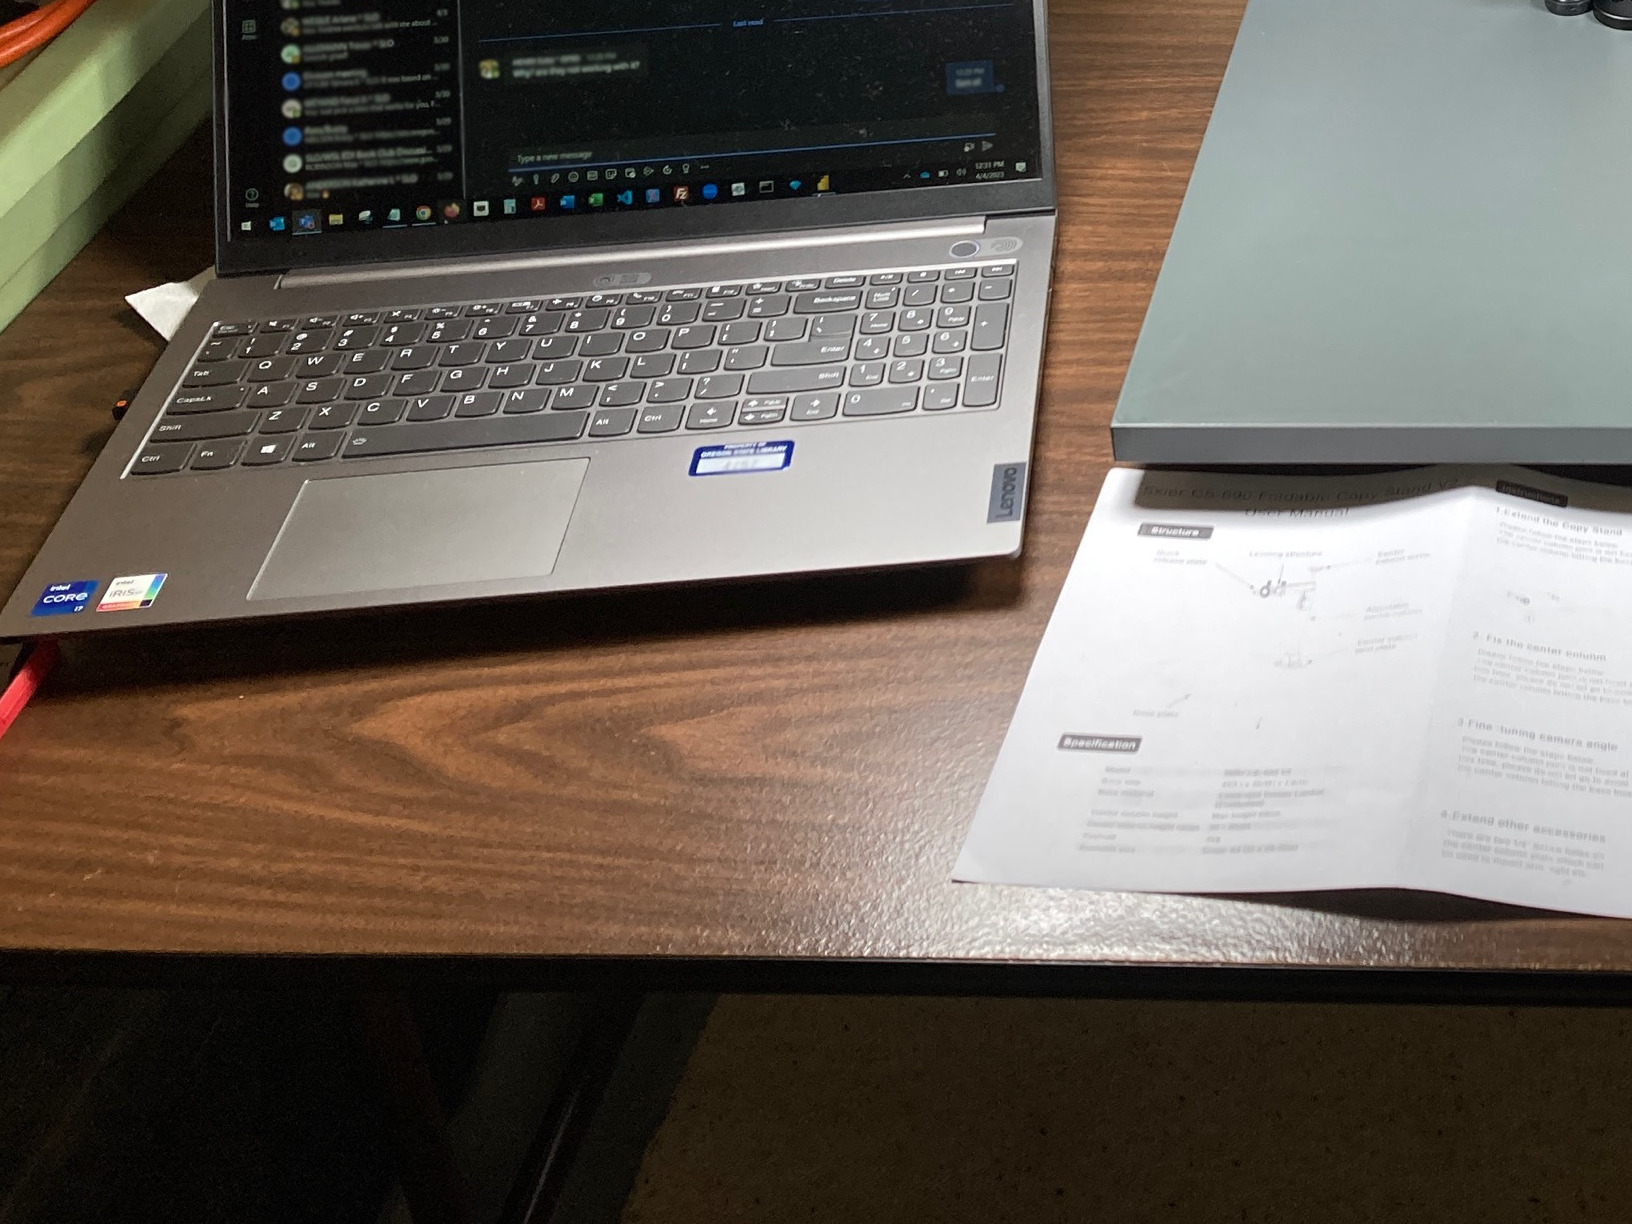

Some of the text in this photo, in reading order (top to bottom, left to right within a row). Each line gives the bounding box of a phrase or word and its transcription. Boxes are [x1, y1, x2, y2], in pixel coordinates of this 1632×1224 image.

[517, 154, 535, 164] Type
[701, 450, 732, 458] OREGON
[756, 445, 788, 453] LIBRARY
[1151, 526, 1201, 537] Structure
